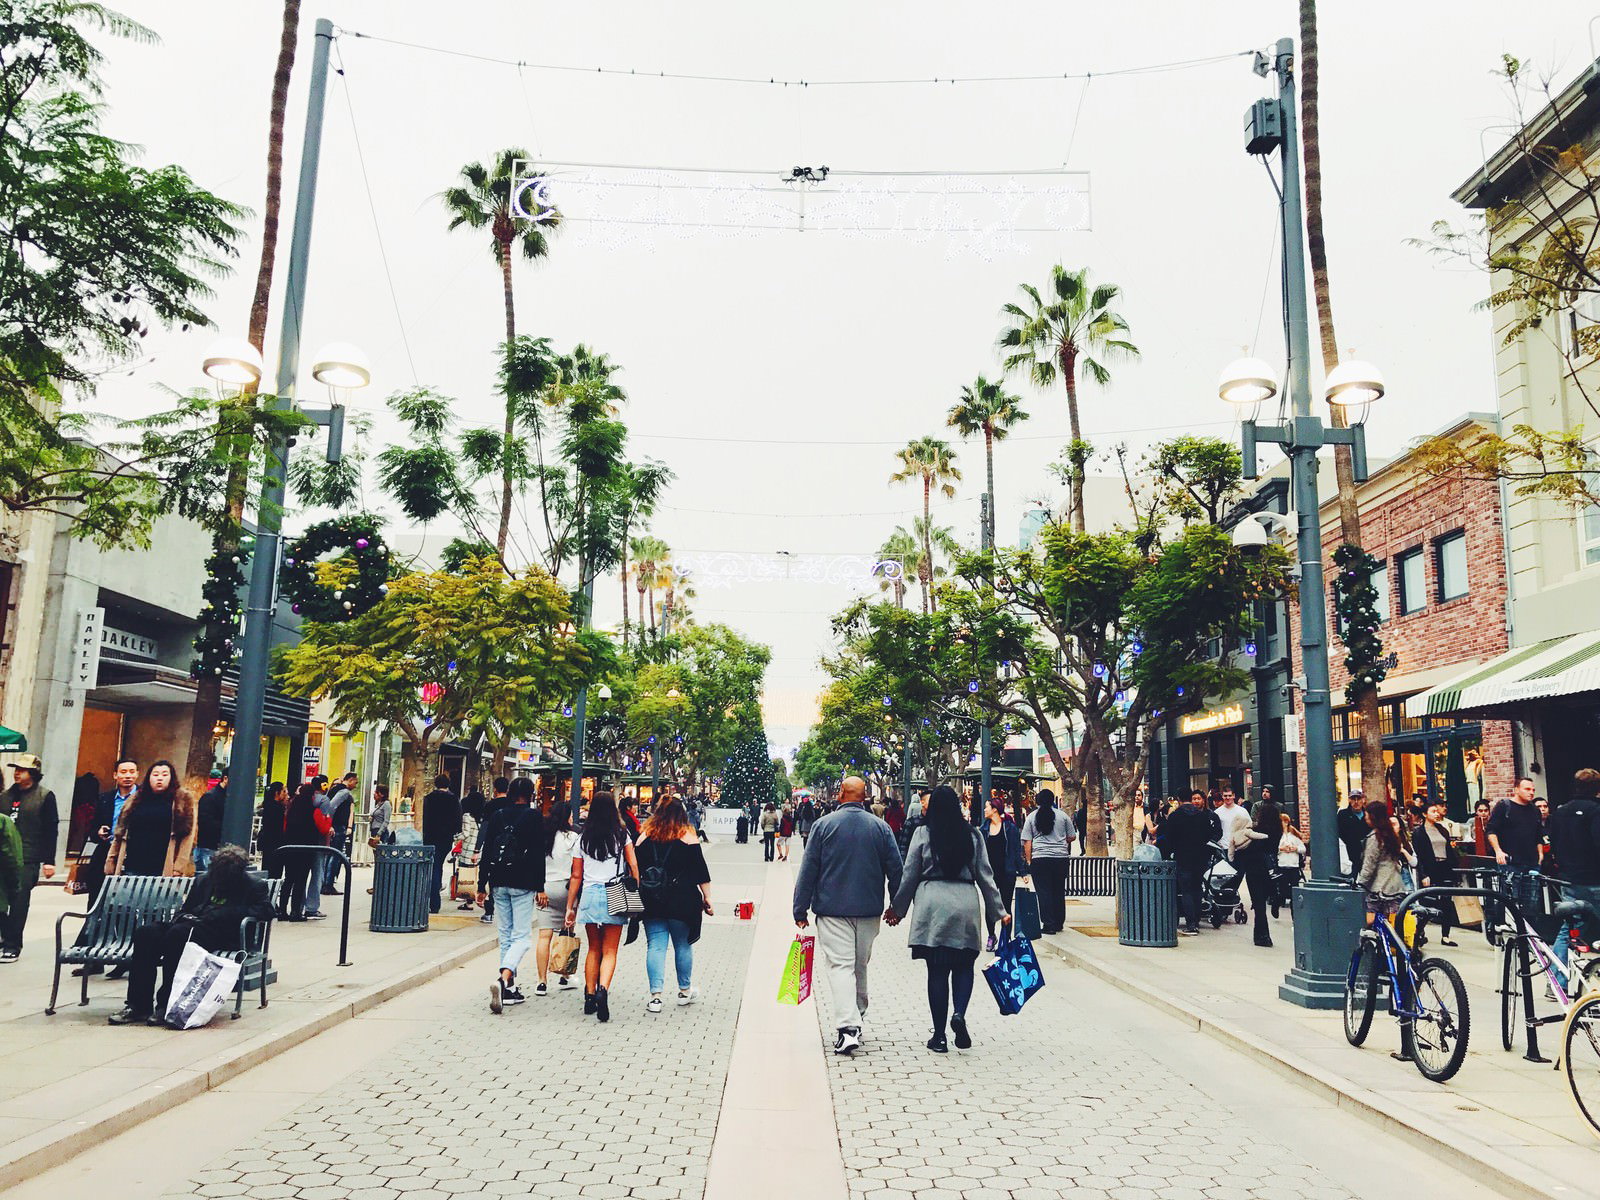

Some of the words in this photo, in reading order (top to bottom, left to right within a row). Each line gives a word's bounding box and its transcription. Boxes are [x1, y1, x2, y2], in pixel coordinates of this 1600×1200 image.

[80, 613, 95, 682] OAKLEY
[101, 629, 155, 654] OAKLEY
[1531, 682, 1560, 693] Beanery
[304, 749, 320, 757] ATM
